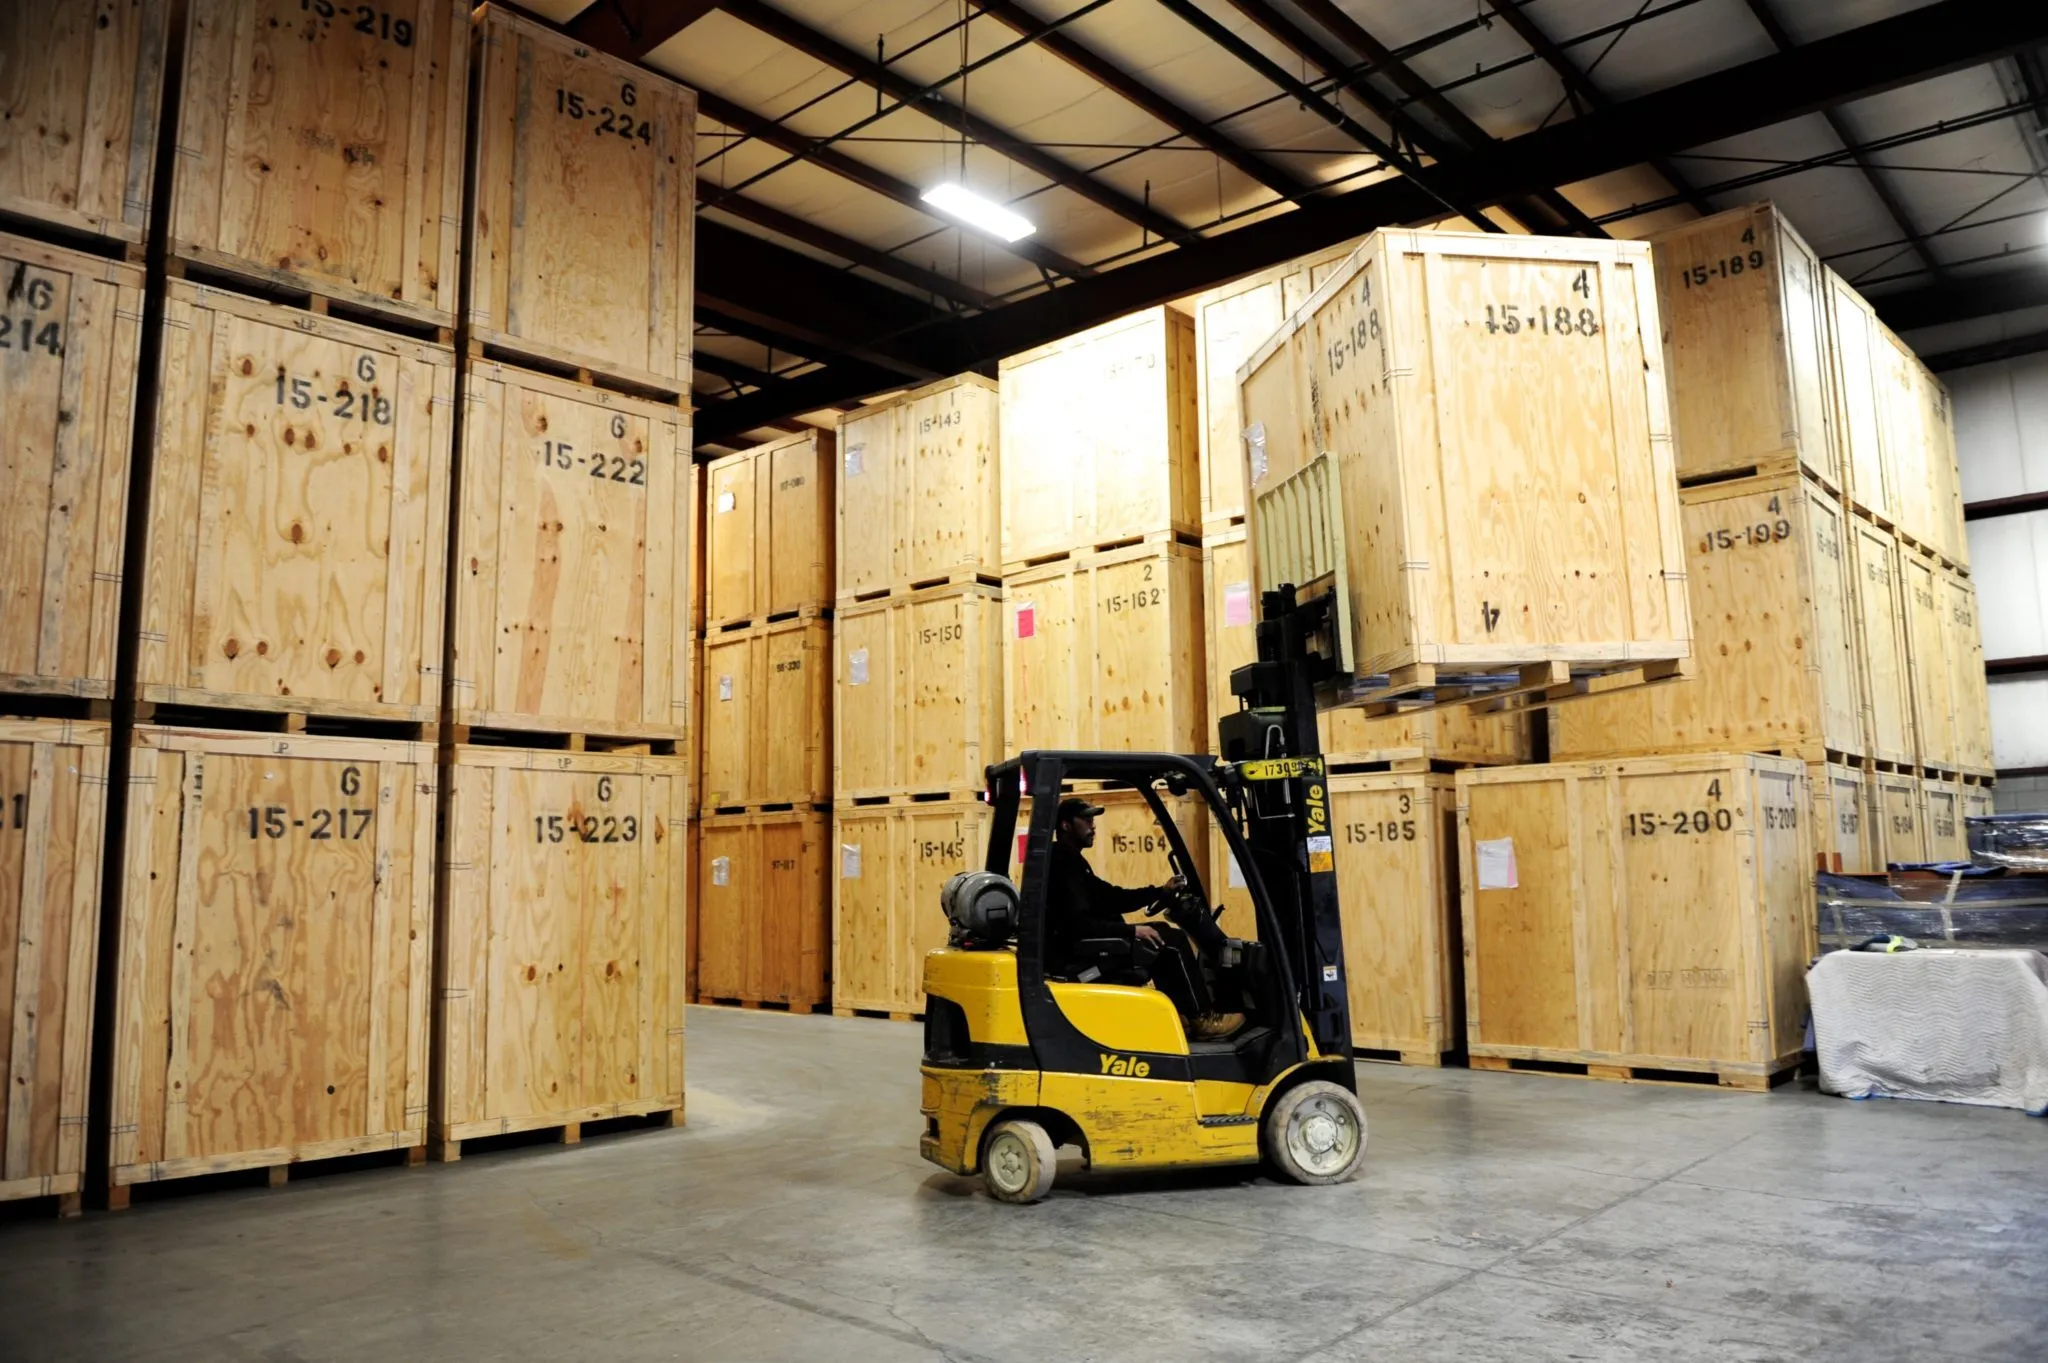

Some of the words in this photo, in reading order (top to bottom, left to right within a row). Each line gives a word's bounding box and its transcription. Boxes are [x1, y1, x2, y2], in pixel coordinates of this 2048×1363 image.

[621, 83, 637, 107] 6
[556, 88, 652, 146] 15-224
[1741, 227, 1755, 244] 4
[1683, 250, 1764, 289] 15-189
[28, 278, 55, 311] 6
[1362, 275, 1371, 307] 4
[1572, 269, 1589, 299] 4
[1484, 304, 1600, 337] 15-188
[1328, 308, 1381, 377] 15-188
[357, 354, 376, 382] 6
[276, 374, 391, 425] 15-218
[611, 415, 625, 439] 6
[919, 411, 961, 435] 15-143
[544, 441, 645, 486] 15-222
[1767, 495, 1781, 516] 4
[1706, 519, 1790, 551] 15-199
[1144, 564, 1153, 581] 2
[955, 603, 959, 620] 1
[1106, 588, 1160, 614] 15-162
[919, 624, 962, 645] 15-150
[340, 766, 360, 796] 6
[597, 776, 612, 802] 6
[1707, 778, 1722, 802] 4
[1306, 785, 1326, 834] Yale
[1399, 794, 1411, 815] 3
[1763, 805, 1797, 830] 15-200
[248, 807, 373, 839] 15-217
[535, 815, 637, 844] 15-223
[955, 820, 960, 838] 1
[1346, 820, 1416, 844] 15-185
[1627, 808, 1732, 836] 15-200
[920, 840, 963, 861] 15-145
[1112, 834, 1167, 854] 15-164
[1100, 1053, 1151, 1078] Yale
